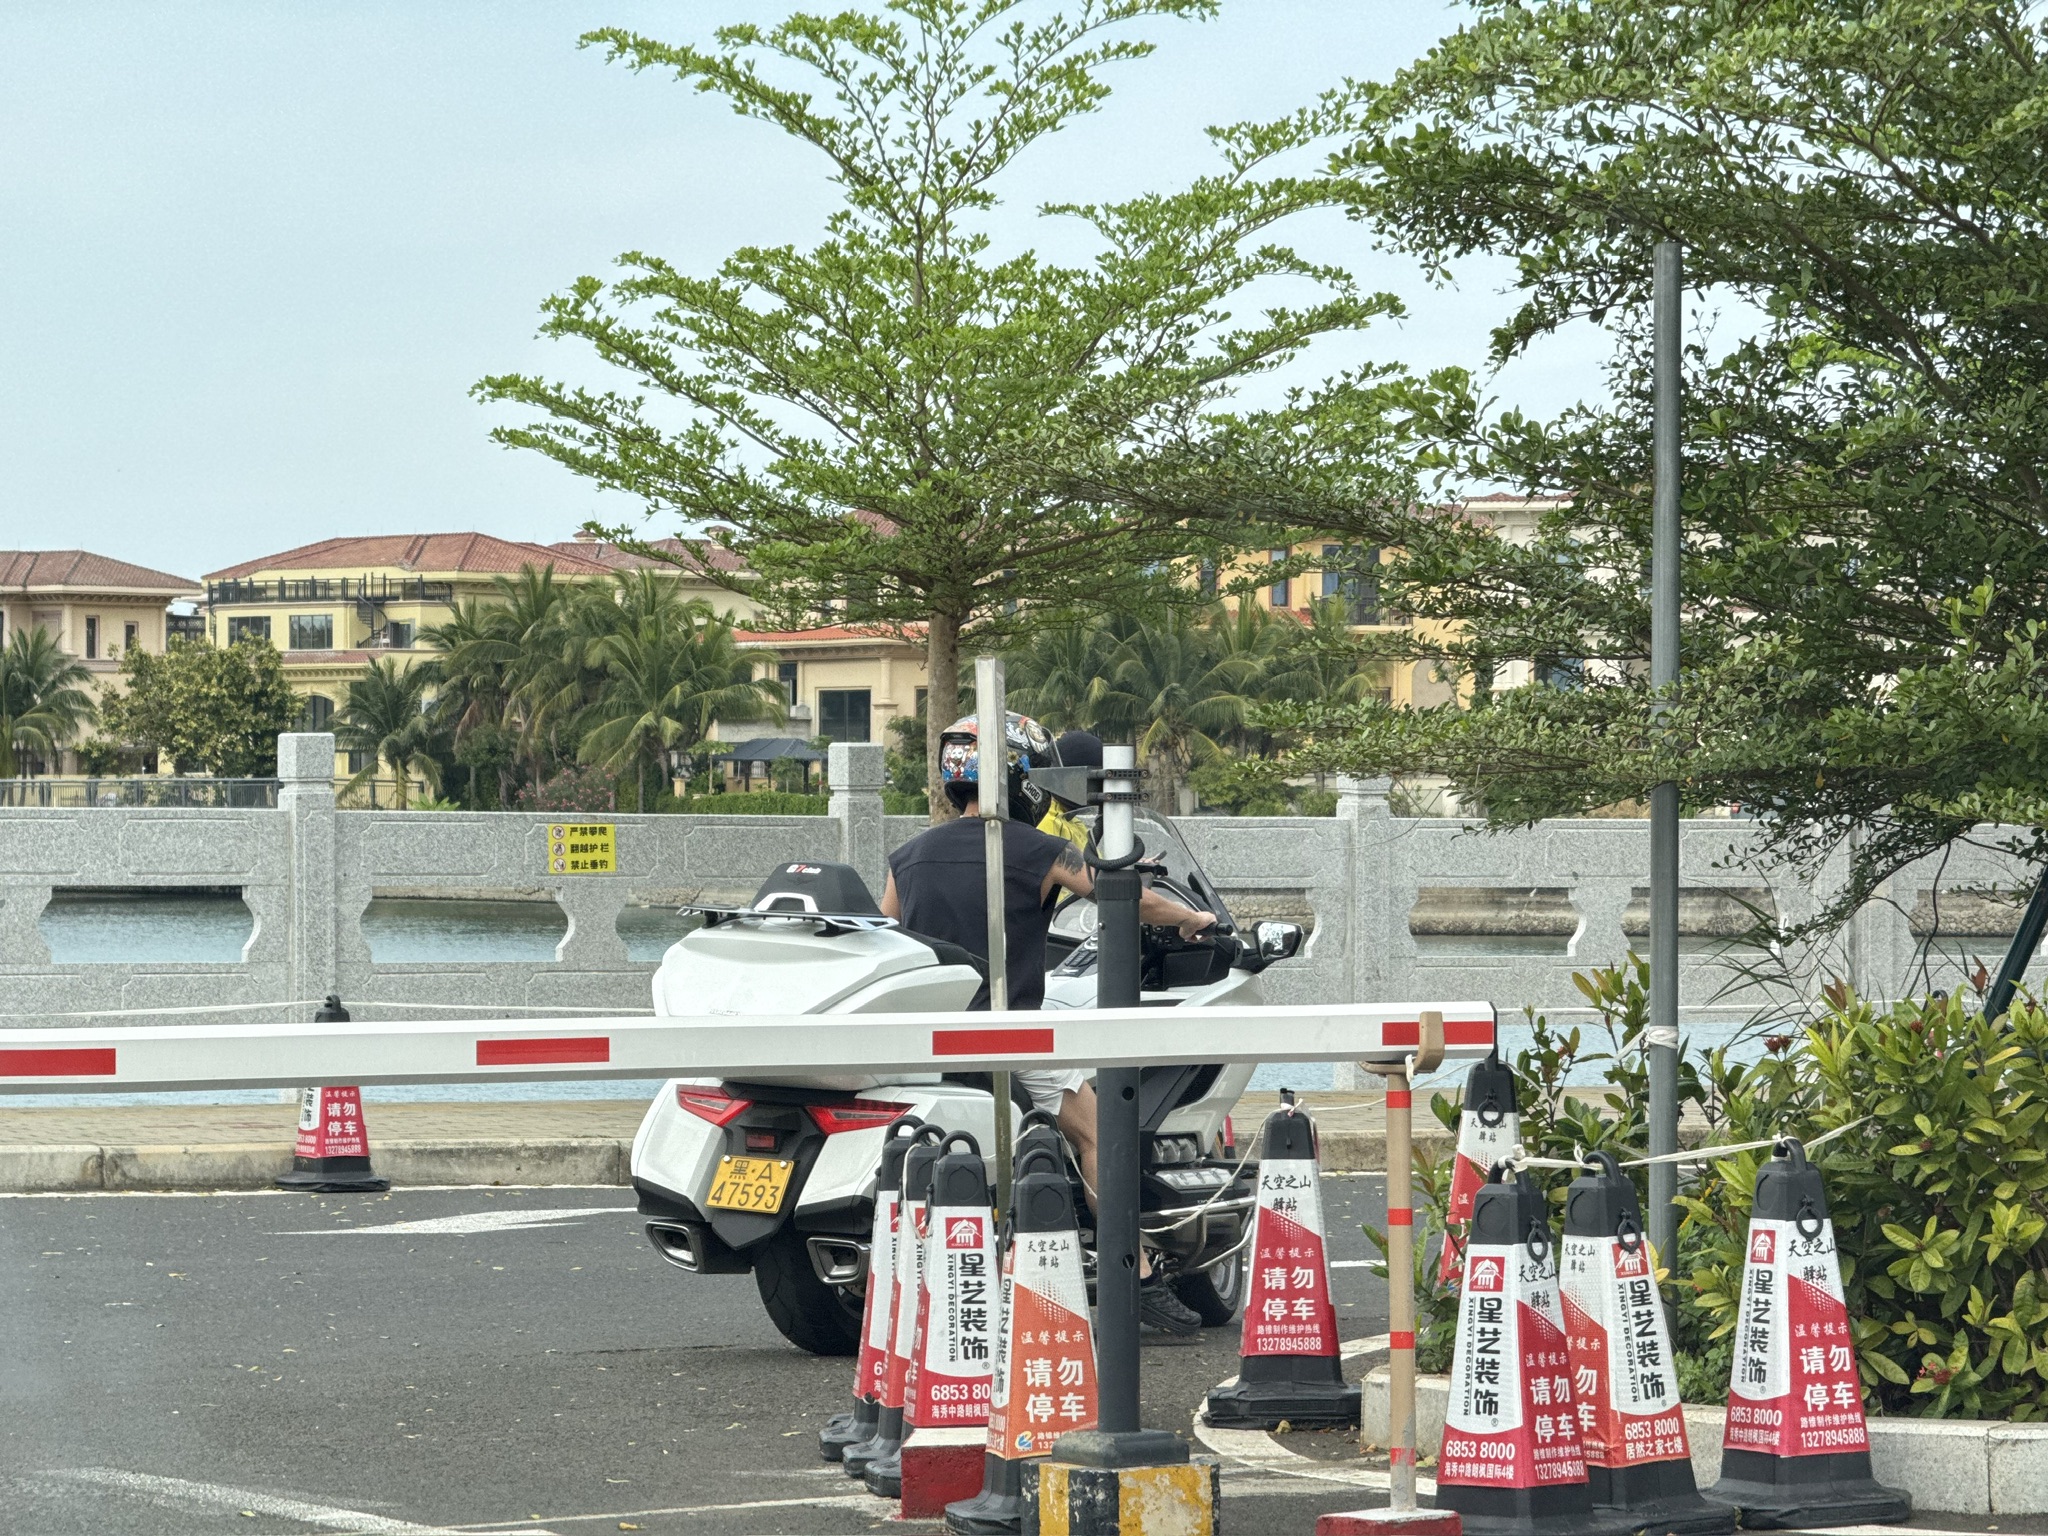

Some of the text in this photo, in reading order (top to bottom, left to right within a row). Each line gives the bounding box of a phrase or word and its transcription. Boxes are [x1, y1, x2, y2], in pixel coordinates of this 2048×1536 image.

[1024, 782, 1041, 801] SHOEI
[569, 826, 608, 837] 严禁攀爬
[570, 843, 609, 854] 翻越护栏
[570, 860, 608, 870] 禁止垂钓
[326, 1102, 356, 1117] 请勿
[327, 1121, 358, 1136] 停车
[1261, 1174, 1312, 1190] 天空之山
[711, 1181, 780, 1209] 47593
[1027, 1240, 1070, 1253] 天空之山
[1260, 1247, 1315, 1259] 温馨提示
[1565, 1243, 1596, 1256] 天空之山
[1788, 1238, 1836, 1258] 天空之山
[1262, 1266, 1314, 1290] 请勿
[1519, 1262, 1556, 1282] 天空之山
[947, 1253, 956, 1362] XINGYI DECORATION
[959, 1253, 989, 1360] 星艺装饰
[1262, 1297, 1316, 1321] 停车
[1748, 1268, 1774, 1384] 星艺装饰
[1794, 1322, 1848, 1338] 温馨提示
[1021, 1330, 1085, 1345] 温馨提示
[1257, 1337, 1322, 1351] 13278945888
[1566, 1336, 1601, 1351] 馨提示
[1617, 1283, 1639, 1403] XINGYI DECORATION
[1629, 1279, 1665, 1400] 星艺装饰
[1474, 1297, 1504, 1416] 星艺装饰
[1525, 1352, 1567, 1367] 温馨提示
[1799, 1344, 1851, 1375] 请勿
[1023, 1356, 1084, 1387] 请勿
[1463, 1342, 1473, 1416] DECORATION
[1575, 1364, 1598, 1395] 勿
[931, 1384, 968, 1401] 6853
[972, 1383, 991, 1400] 80
[1530, 1375, 1571, 1405] 请勿
[1803, 1381, 1856, 1412] 停车
[932, 1403, 990, 1418] 海秀中路朗枫国
[1025, 1392, 1087, 1423] 停车
[1577, 1402, 1597, 1432] 车
[1730, 1406, 1782, 1426] 6853 8000
[1534, 1413, 1576, 1444] 停车
[1625, 1417, 1679, 1440] 6853 8000
[1800, 1412, 1863, 1428] 路锥制作维护热线
[1801, 1427, 1865, 1448] 13278945888
[1445, 1440, 1516, 1460] 6853 8000
[1625, 1436, 1683, 1460] 居然之家七楼
[1535, 1460, 1585, 1480] 13278945888
